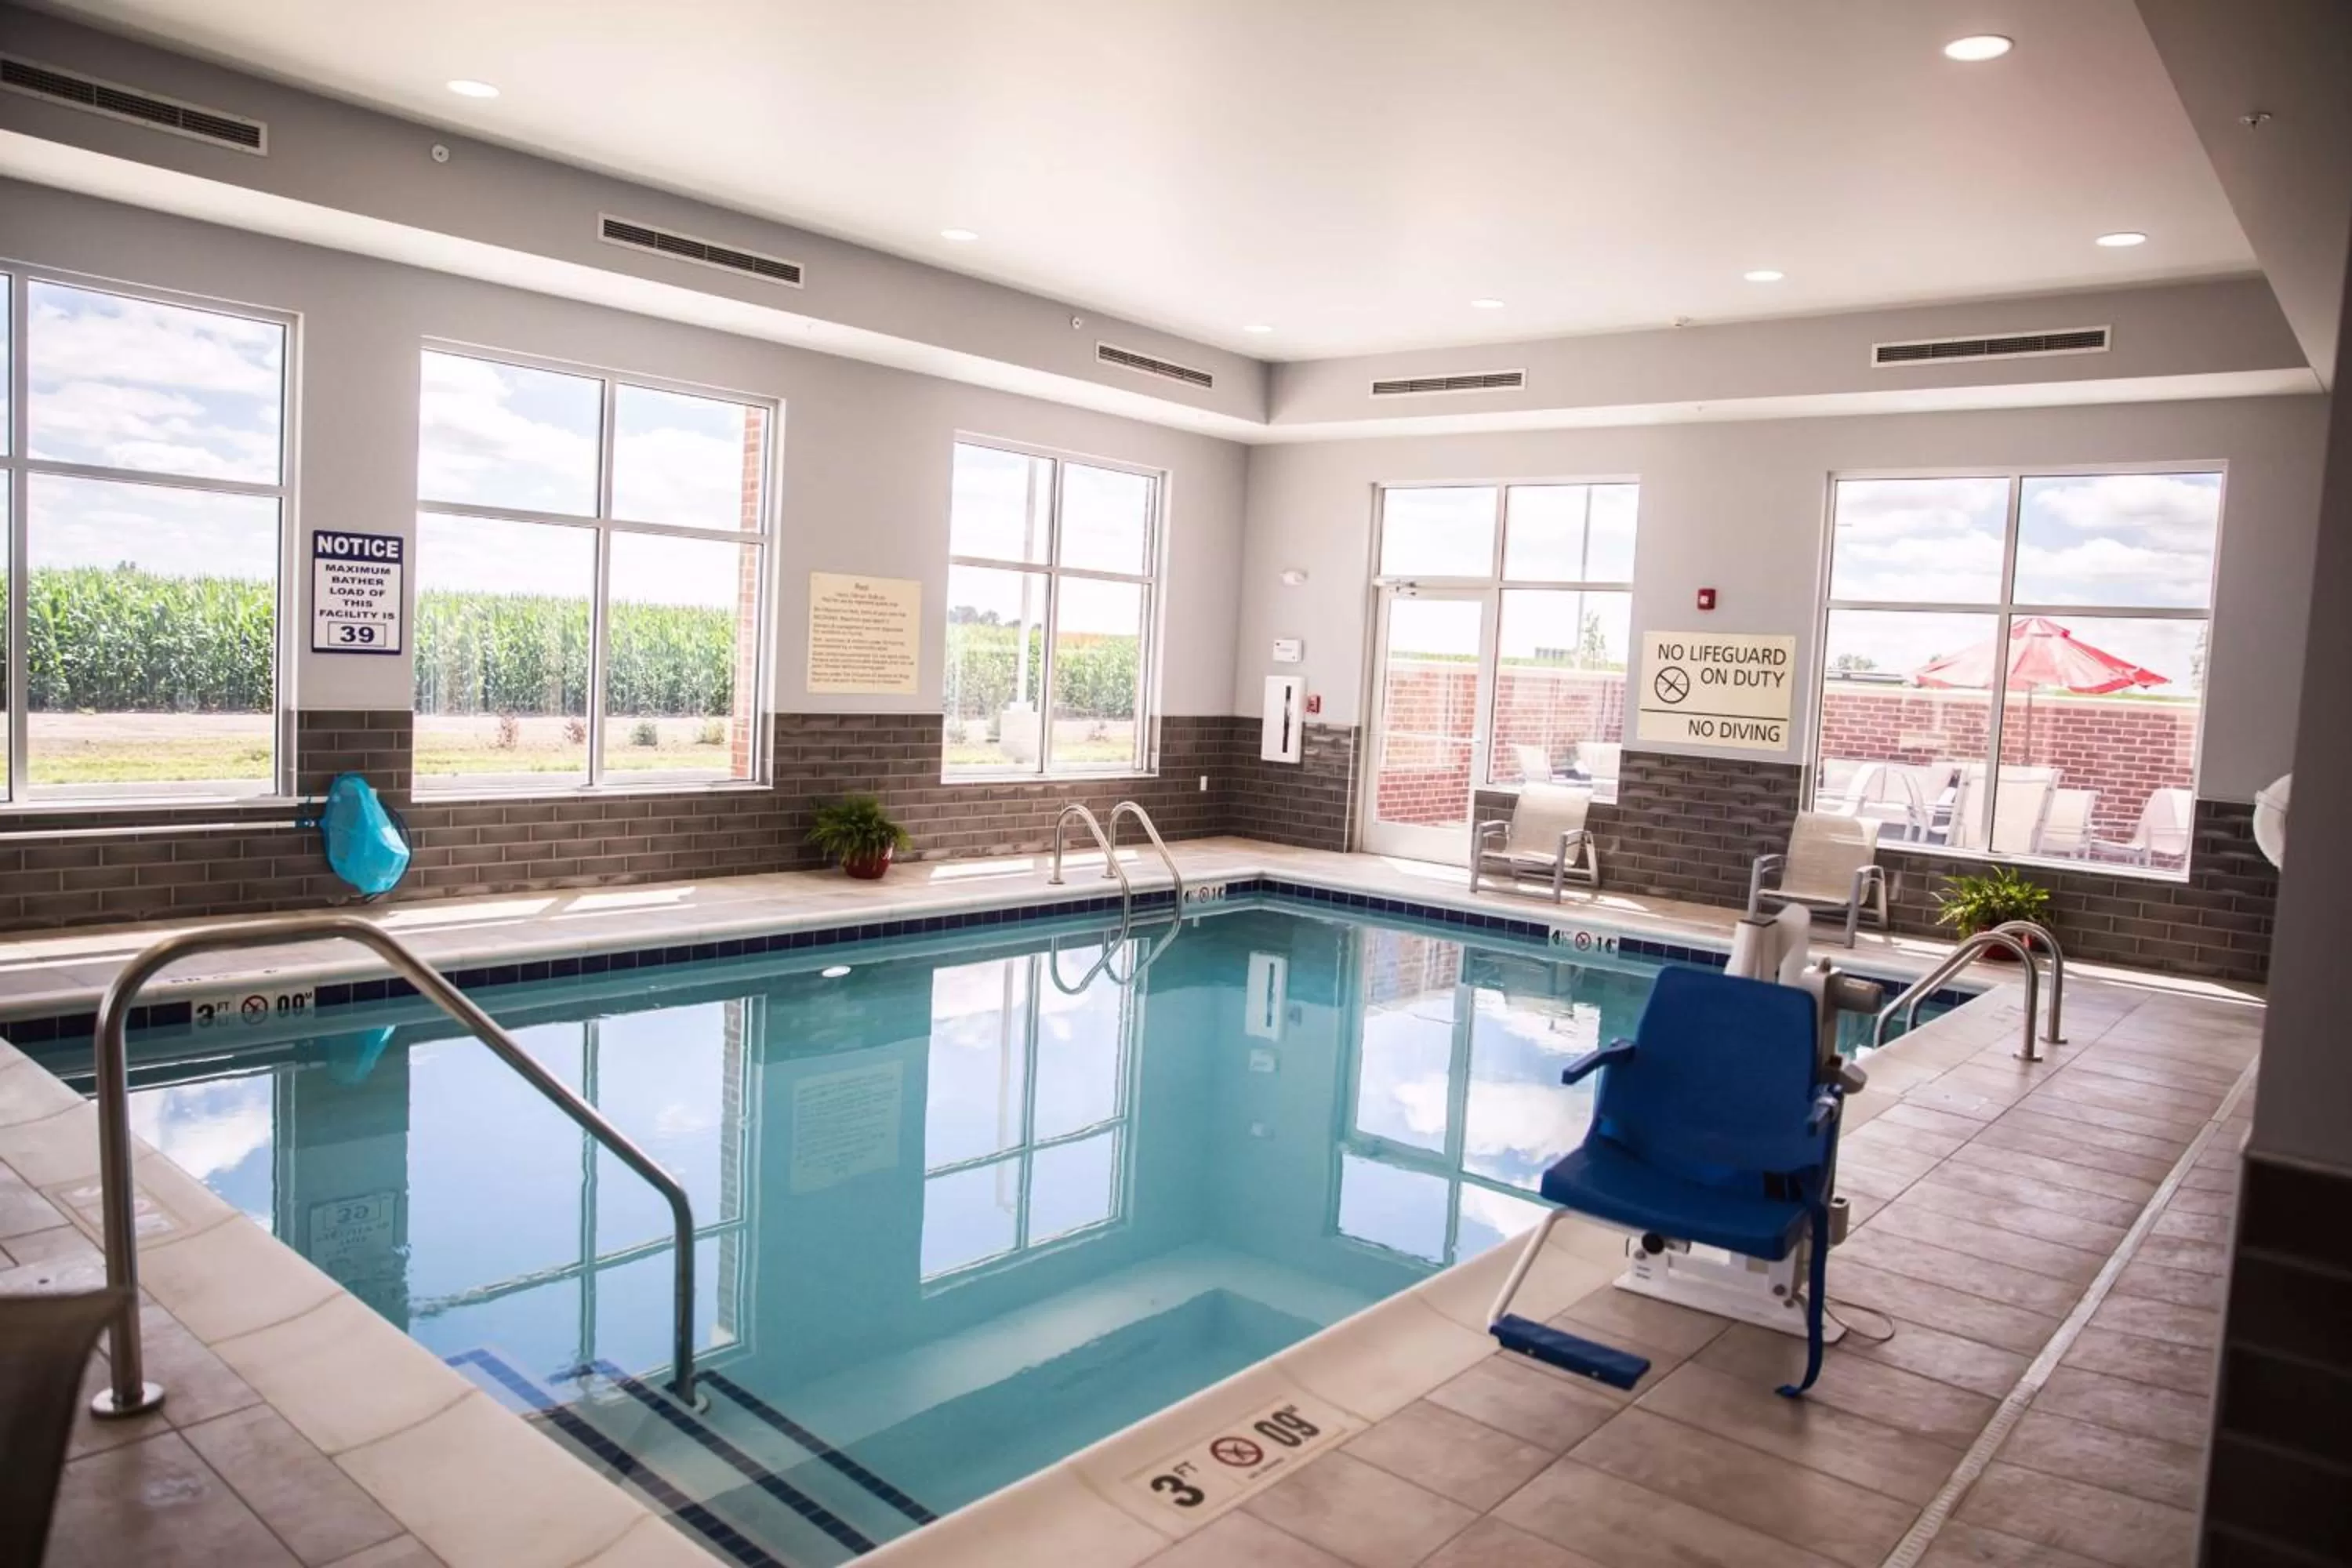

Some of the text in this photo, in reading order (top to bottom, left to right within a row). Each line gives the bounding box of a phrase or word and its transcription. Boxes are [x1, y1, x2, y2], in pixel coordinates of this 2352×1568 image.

[317, 535, 399, 558] NOTICE
[325, 564, 391, 575] MAXIMUM
[332, 576, 384, 586] BATHER
[329, 587, 386, 597] LOAD OF
[343, 599, 373, 608] THIS
[319, 609, 378, 619] FACILITY
[339, 626, 375, 643] 39
[1658, 644, 1787, 666] NO LIFEGUARD
[1700, 667, 1785, 688] ON DUTY
[1688, 719, 1780, 742] NO DIVING
[1150, 1475, 1205, 1508] 3
